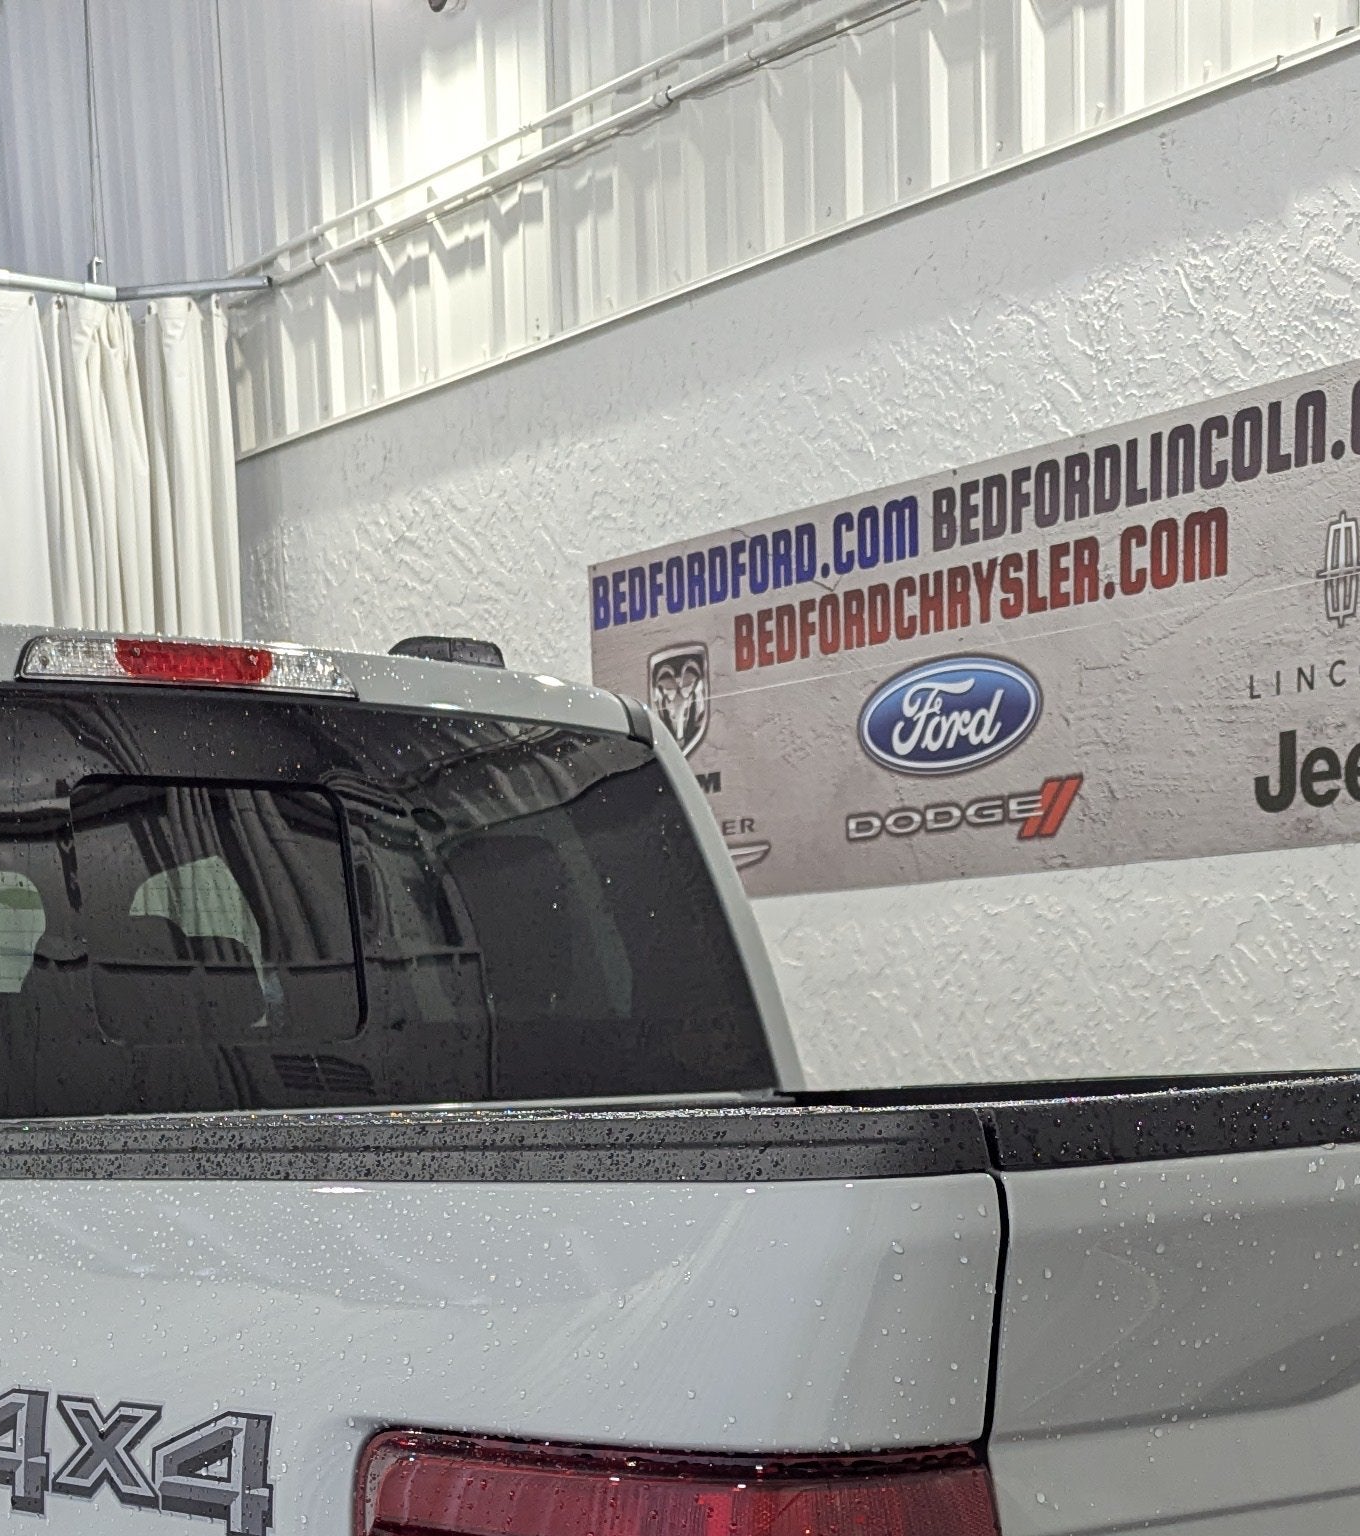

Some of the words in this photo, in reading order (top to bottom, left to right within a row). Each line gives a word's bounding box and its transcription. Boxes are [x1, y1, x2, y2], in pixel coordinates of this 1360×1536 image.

[592, 495, 919, 631] BEDFORDFORD.COM
[734, 506, 1228, 672] BEDFORDCHRYSLER.COM
[892, 678, 1005, 756] Ford
[846, 793, 1044, 841] DODGE
